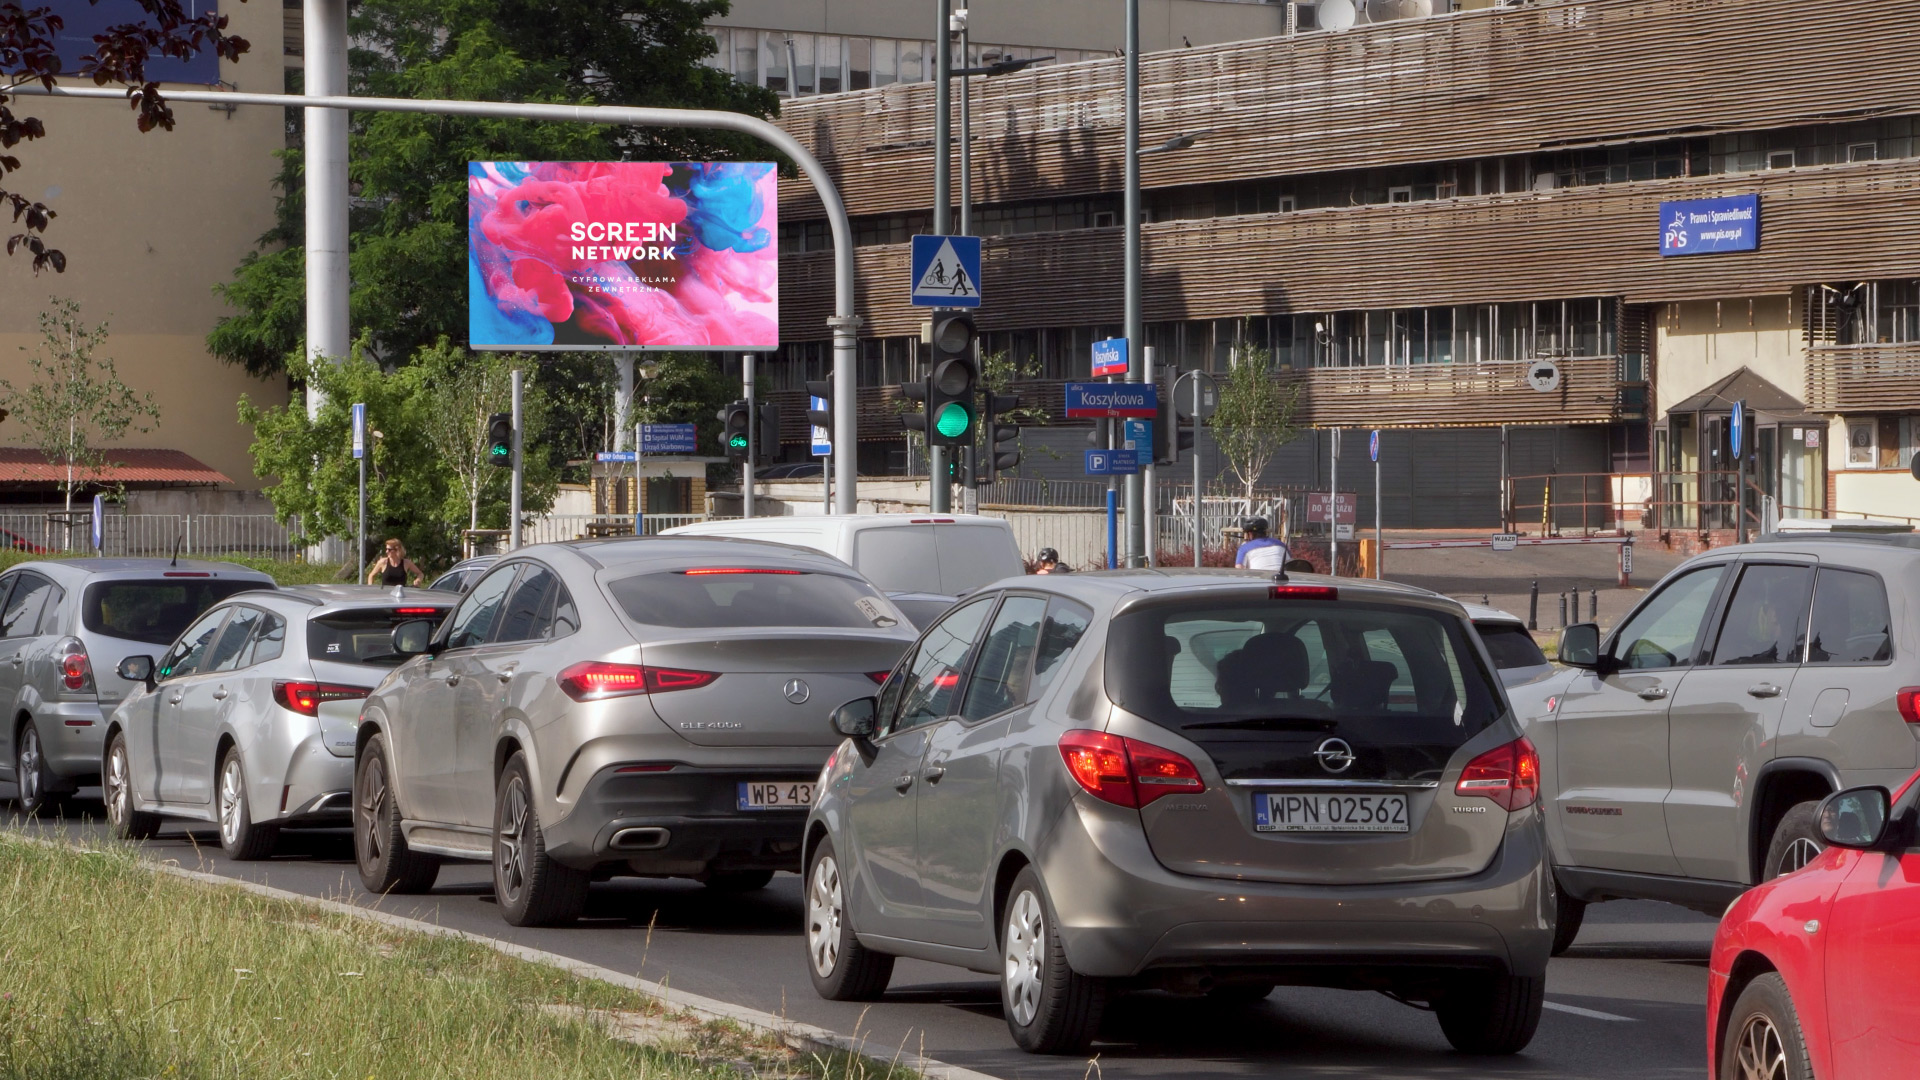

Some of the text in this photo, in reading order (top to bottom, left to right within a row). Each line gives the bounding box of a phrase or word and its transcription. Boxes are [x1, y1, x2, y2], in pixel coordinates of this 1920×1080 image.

[1690, 207, 1752, 225] Prawo i Sprawiedliwość
[571, 222, 676, 241] SCREEN
[1700, 227, 1742, 241] www.pis.org.pl
[1665, 230, 1687, 249] PiS
[572, 246, 676, 260] NETWORK
[1081, 391, 1144, 409] Koszykowa
[1107, 409, 1120, 417] Filtry
[652, 434, 668, 442] Szpital
[660, 443, 685, 451] Skarbowy
[1093, 456, 1103, 469] P
[1312, 504, 1322, 512] DO
[753, 784, 816, 805] WB 43
[1165, 803, 1209, 811] MERIVA
[1269, 796, 1406, 824] WPN 02562
[1257, 813, 1268, 821] PL
